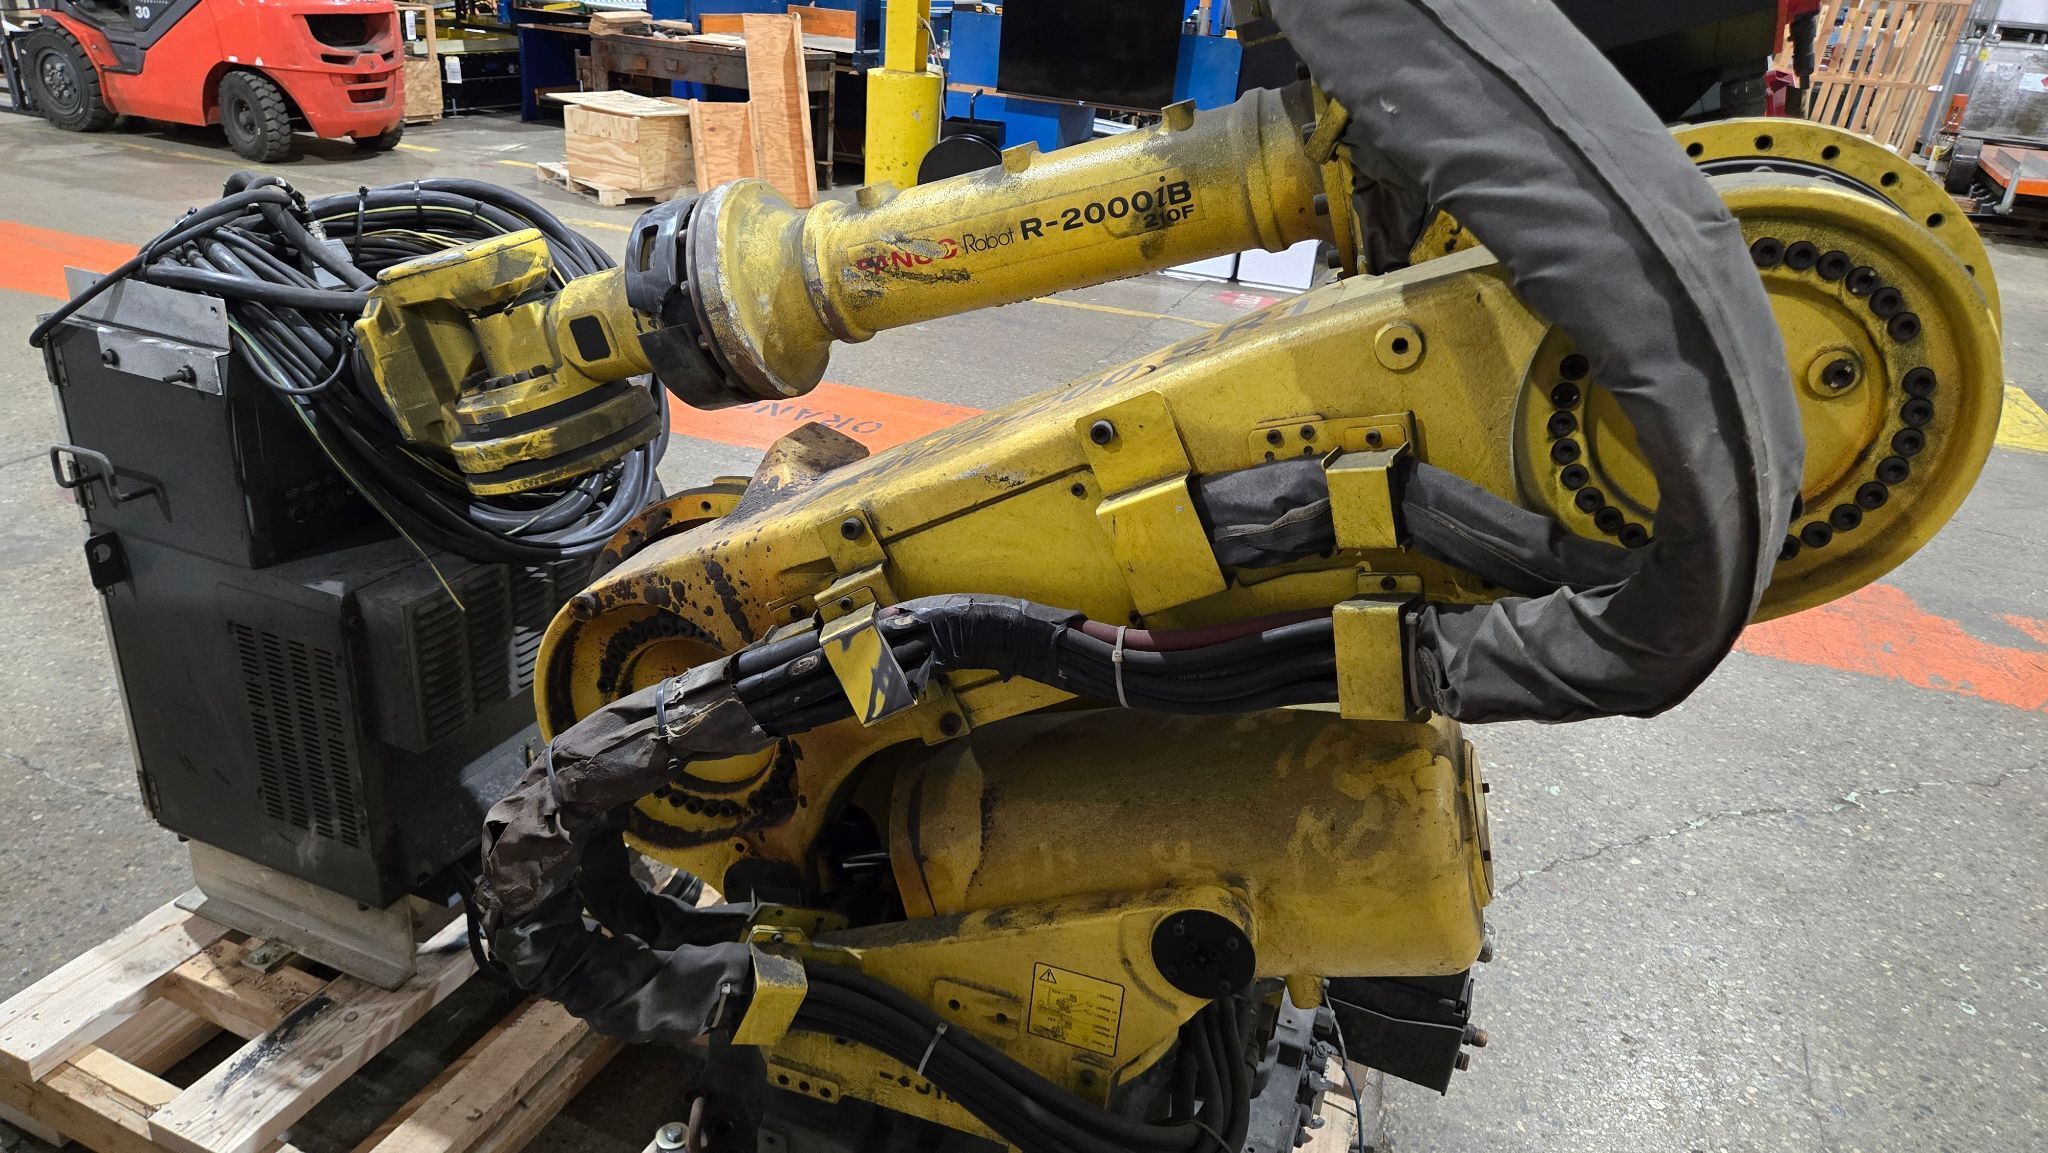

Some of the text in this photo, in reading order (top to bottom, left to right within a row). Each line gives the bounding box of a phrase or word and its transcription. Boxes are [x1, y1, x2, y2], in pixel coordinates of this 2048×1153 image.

[135, 6, 151, 19] 30
[962, 227, 1014, 254] Robot
[1020, 175, 1192, 240] R-2000iB
[1144, 204, 1194, 229] 210F
[736, 401, 883, 434] ORAN
